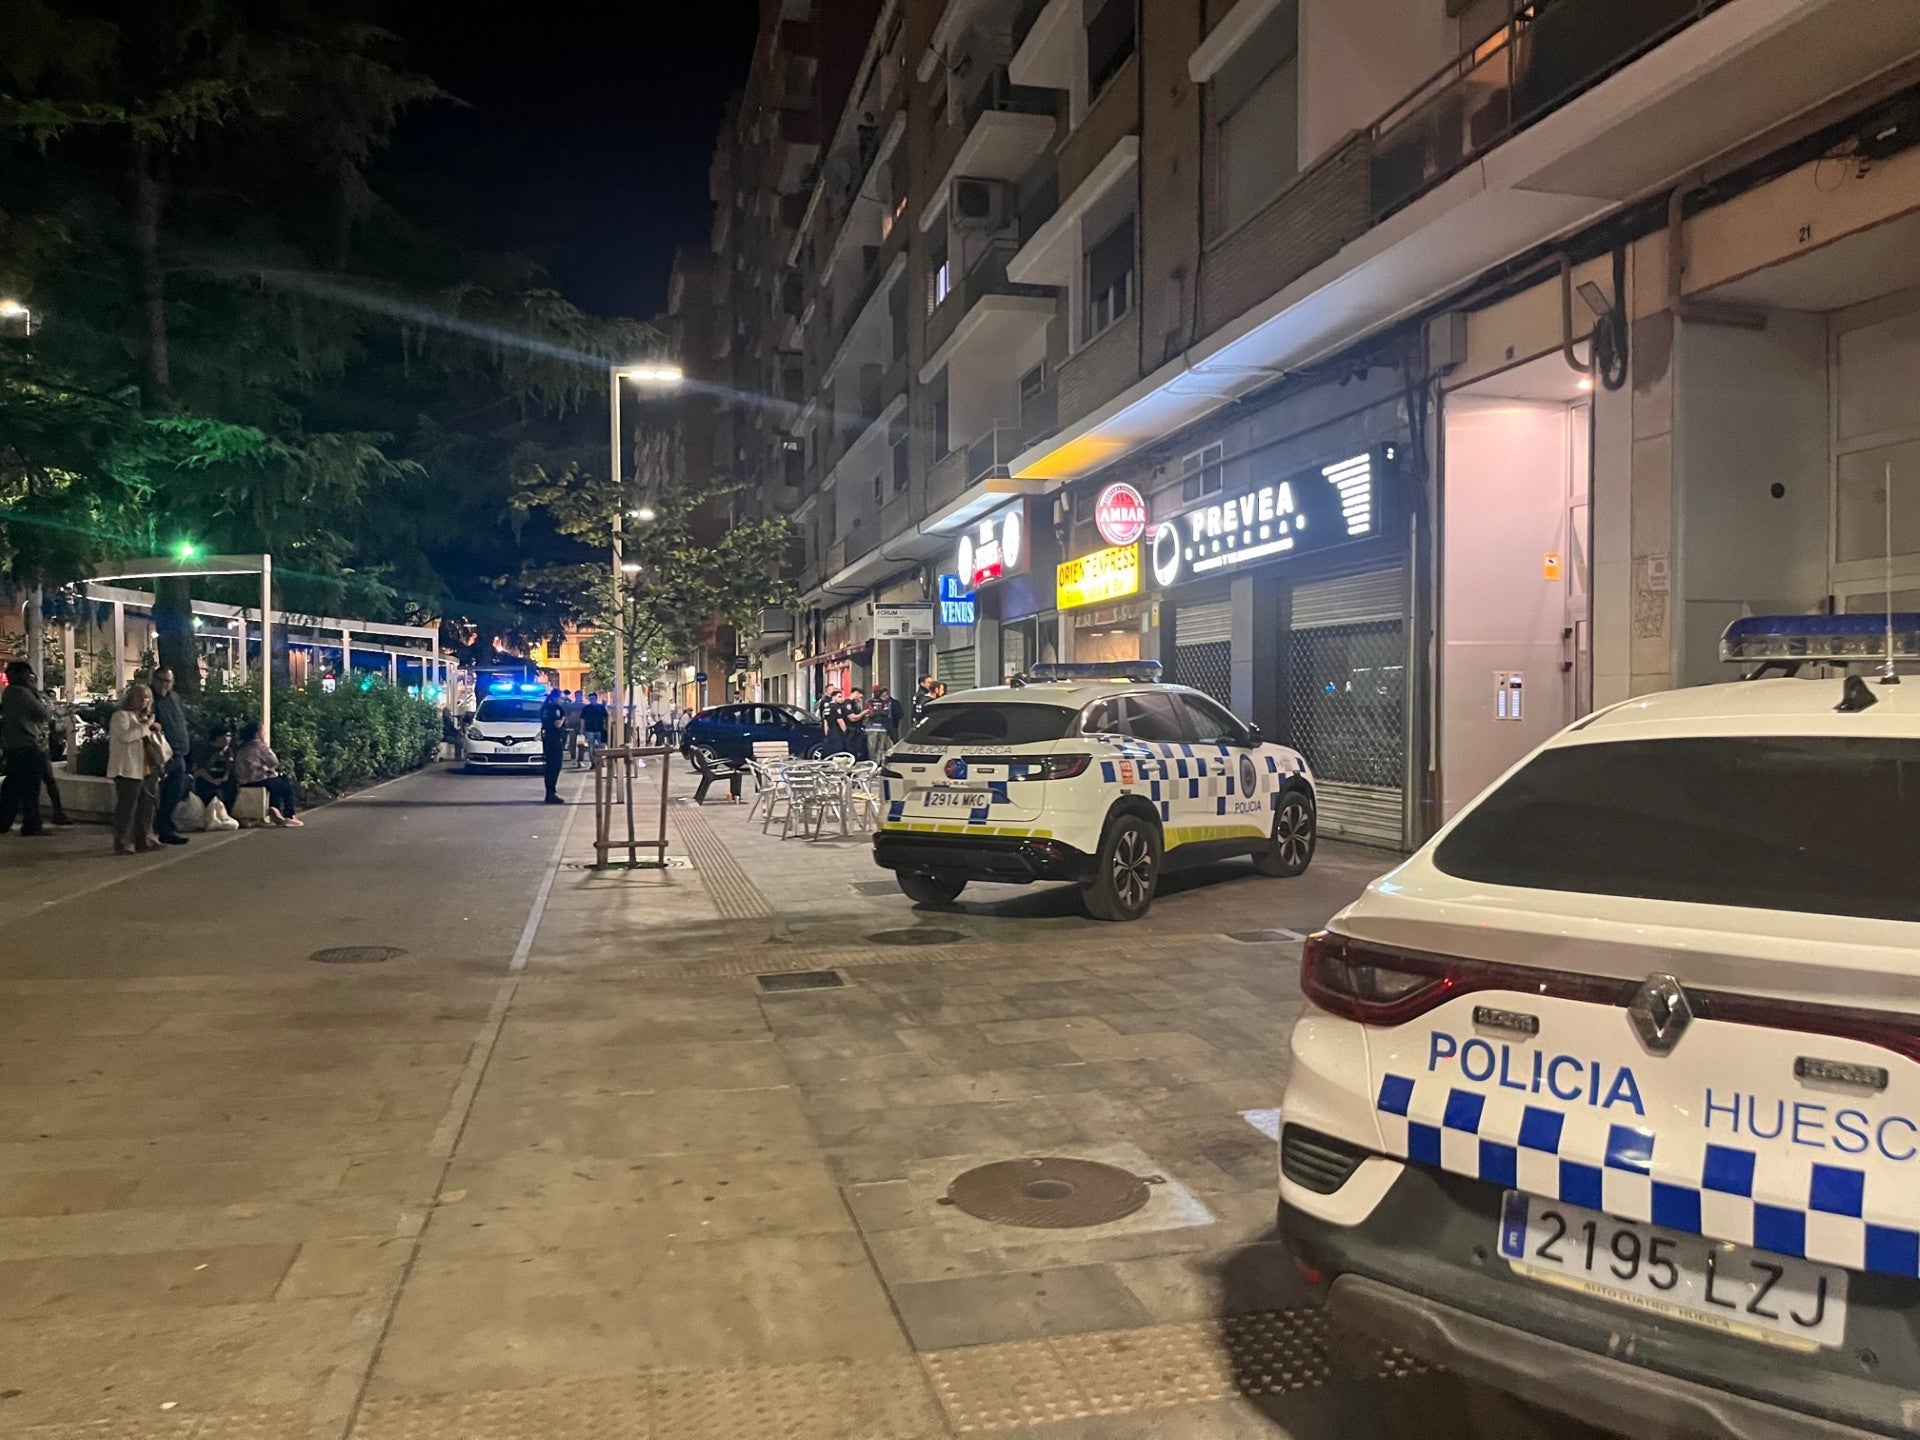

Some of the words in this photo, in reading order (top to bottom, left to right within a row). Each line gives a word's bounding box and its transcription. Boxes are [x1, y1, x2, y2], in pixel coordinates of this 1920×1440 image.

[1798, 224, 1811, 243] 21
[1100, 507, 1146, 522] AMBAR
[1192, 481, 1294, 542] PREVEA
[877, 609, 898, 617] FORUM
[941, 601, 974, 623] VENUS
[906, 745, 949, 754] POLICIA
[961, 745, 1013, 754] HUESCA
[931, 792, 958, 806] 2914
[962, 794, 985, 807] MKC
[1235, 800, 1262, 814] POLICIA
[1428, 1030, 1645, 1116] POLICIA
[1535, 1211, 1679, 1290] 2195
[1704, 1250, 1828, 1327] LZJ
